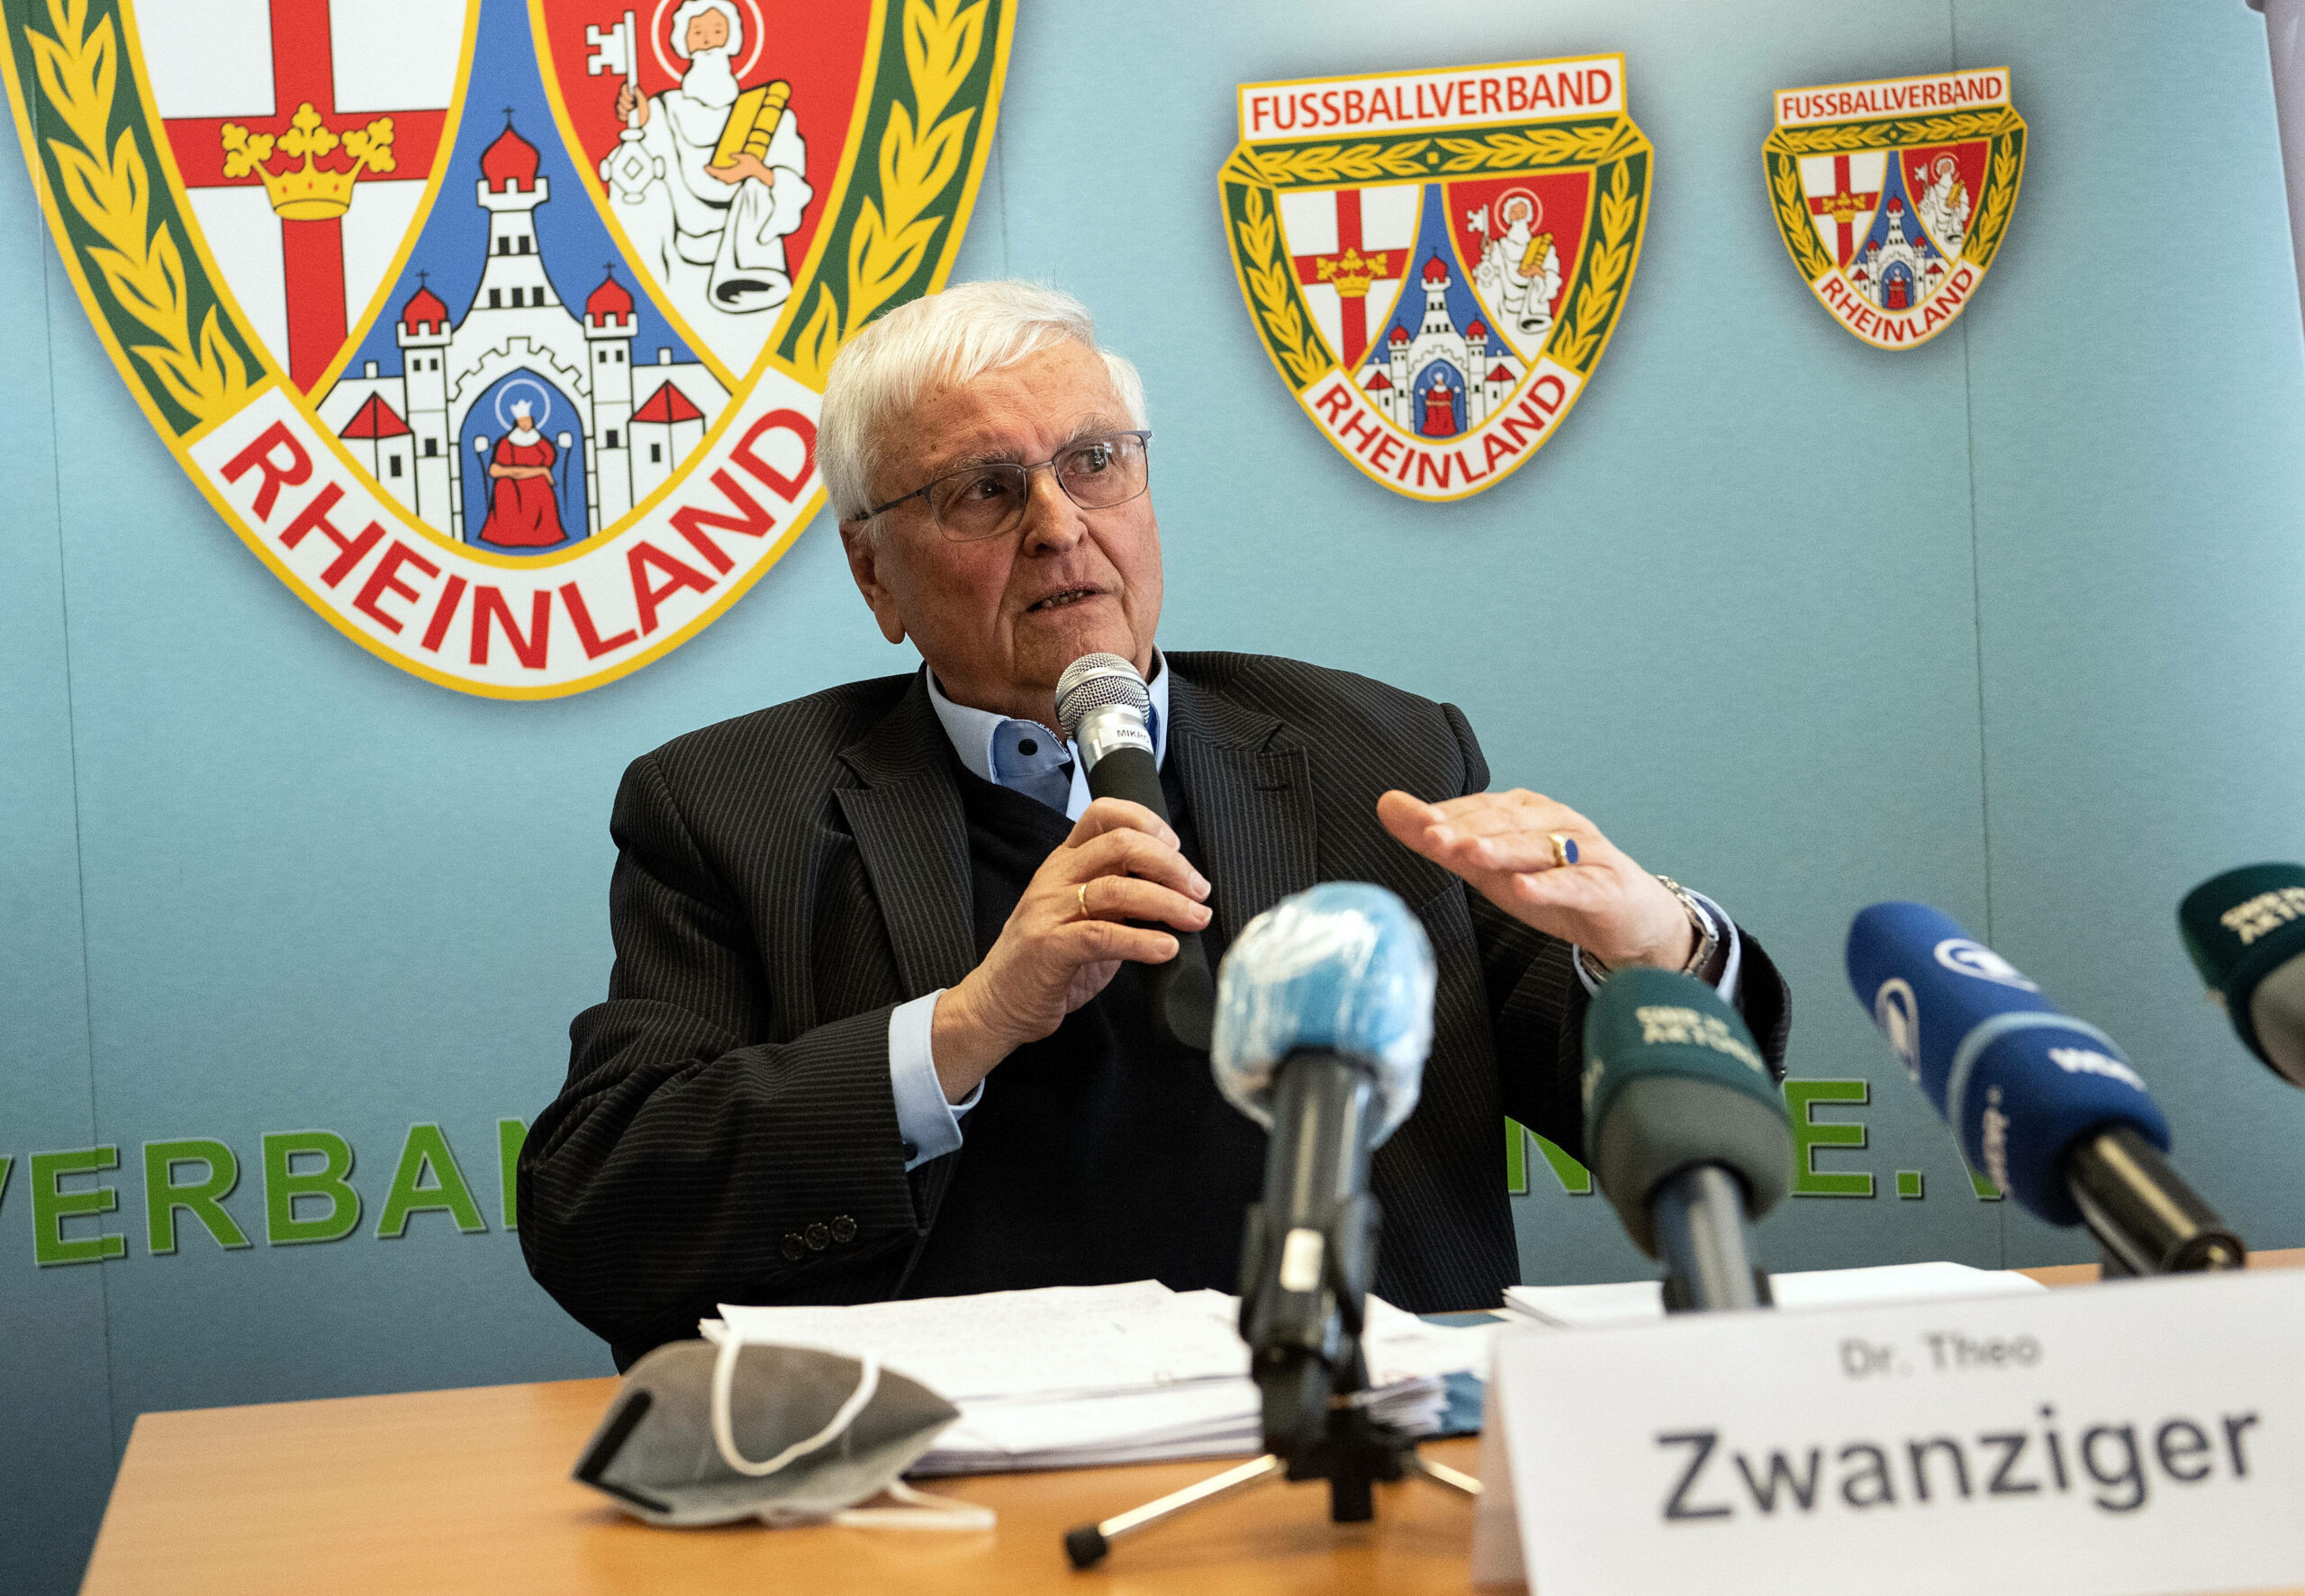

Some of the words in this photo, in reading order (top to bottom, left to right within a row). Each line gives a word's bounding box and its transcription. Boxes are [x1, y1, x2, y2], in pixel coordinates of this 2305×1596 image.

[1252, 68, 1613, 131] FUSSBALLVERBAND
[1782, 76, 2002, 121] FUSSBALLVERBAND
[1821, 267, 1974, 343] RHEINLAND
[1313, 373, 1569, 491] RHEINLAND
[220, 407, 818, 671] RHEINLAND
[0, 1121, 531, 1262] ERBA
[1839, 1338, 1914, 1380] Dr.
[1925, 1330, 2045, 1372] Theo
[1657, 1404, 2260, 1522] Zwanziger
